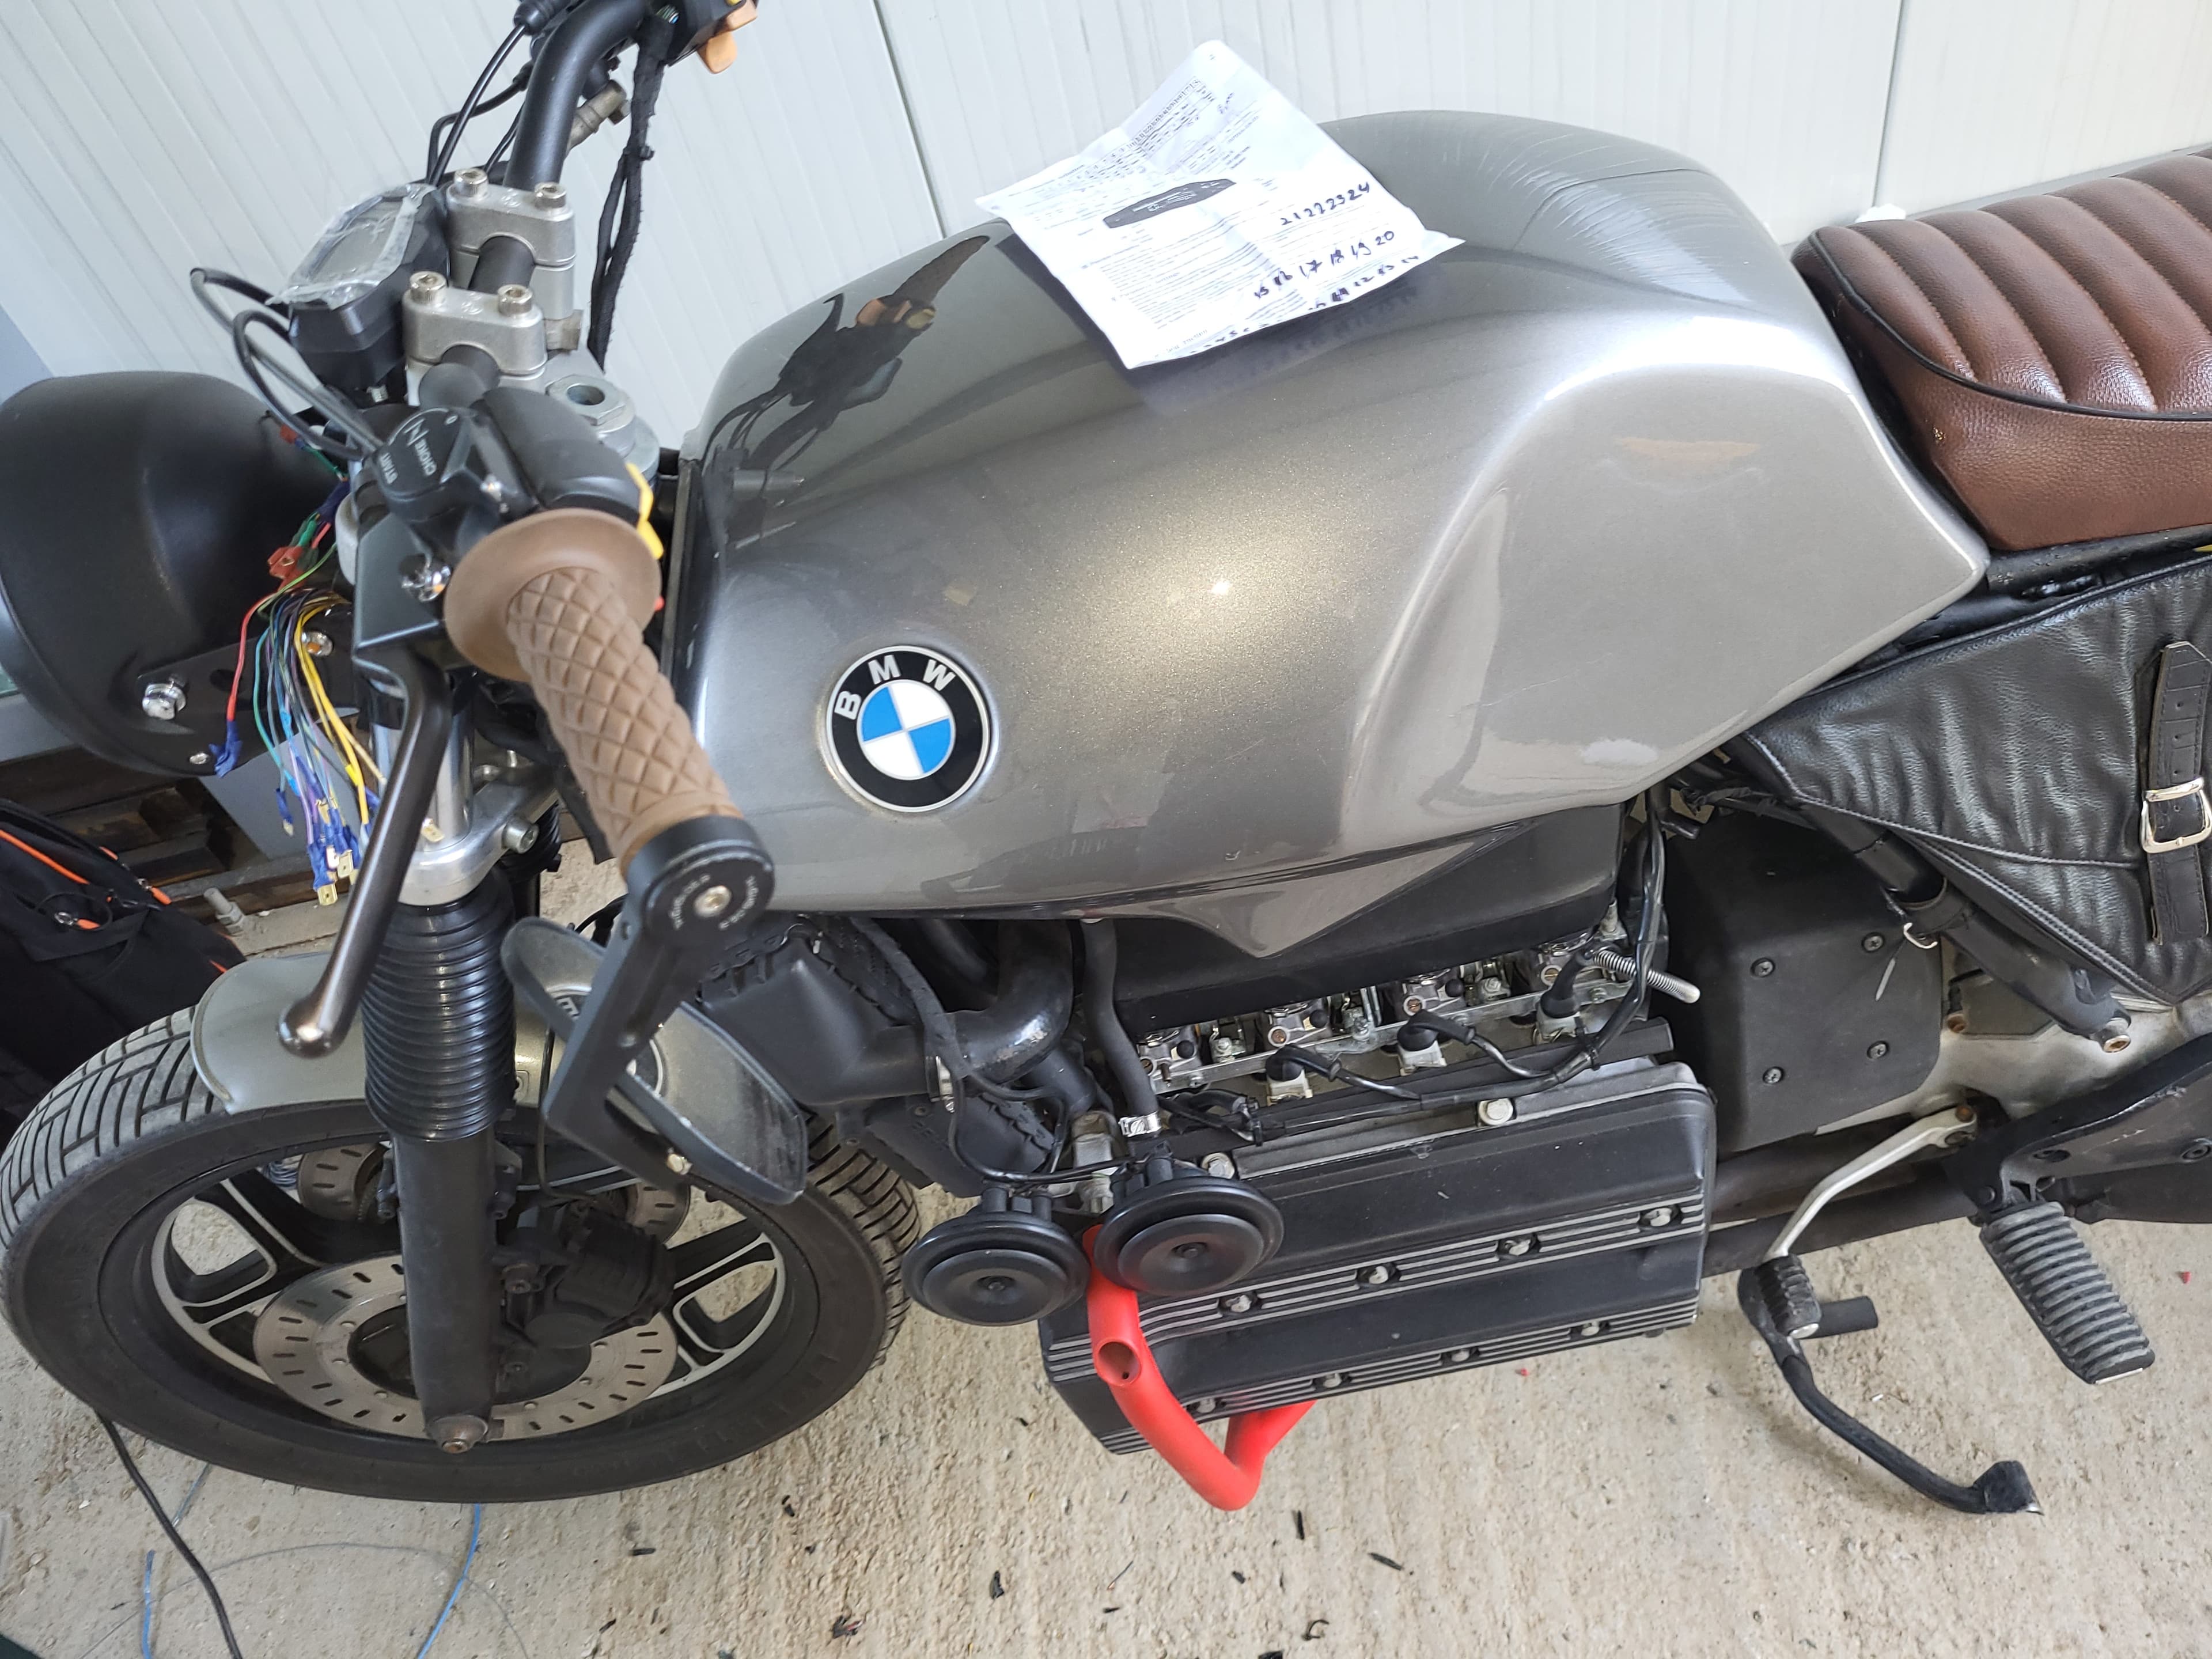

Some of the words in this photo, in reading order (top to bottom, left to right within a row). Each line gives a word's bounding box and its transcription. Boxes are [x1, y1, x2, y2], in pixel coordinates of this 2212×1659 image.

[1298, 260, 1323, 278] 17
[1375, 230, 1395, 245] 20
[379, 452, 398, 484] START
[415, 439, 436, 476] CHOKE
[834, 654, 956, 720] BMW
